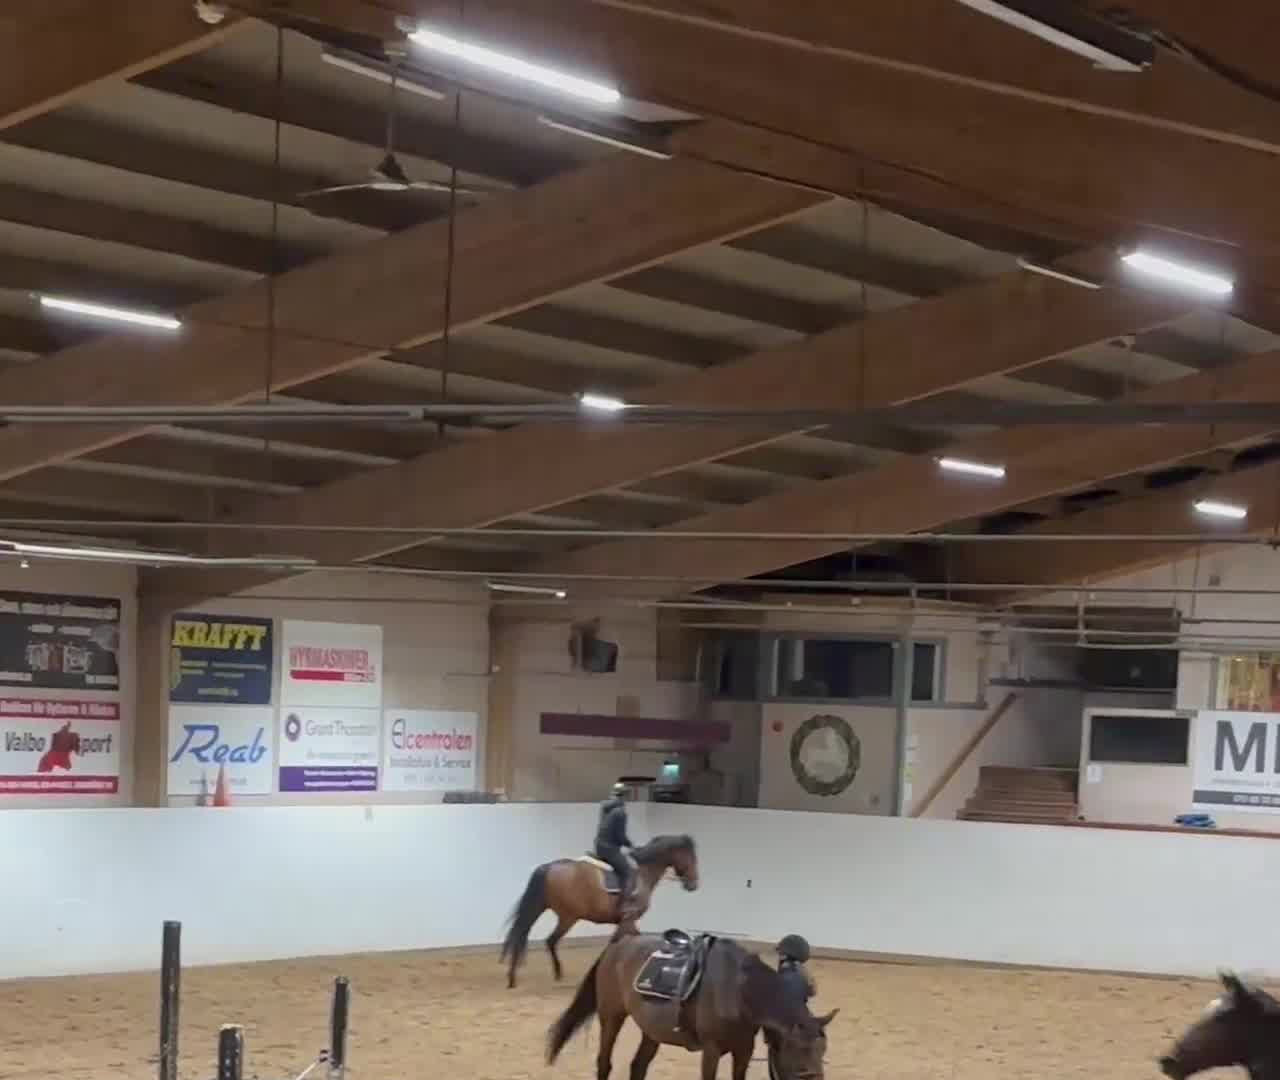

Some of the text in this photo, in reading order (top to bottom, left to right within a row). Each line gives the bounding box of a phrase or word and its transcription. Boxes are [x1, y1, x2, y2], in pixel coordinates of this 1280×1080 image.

[172, 620, 267, 650] KRAFFT
[4, 731, 47, 753] Valbo
[170, 724, 267, 763] Reab
